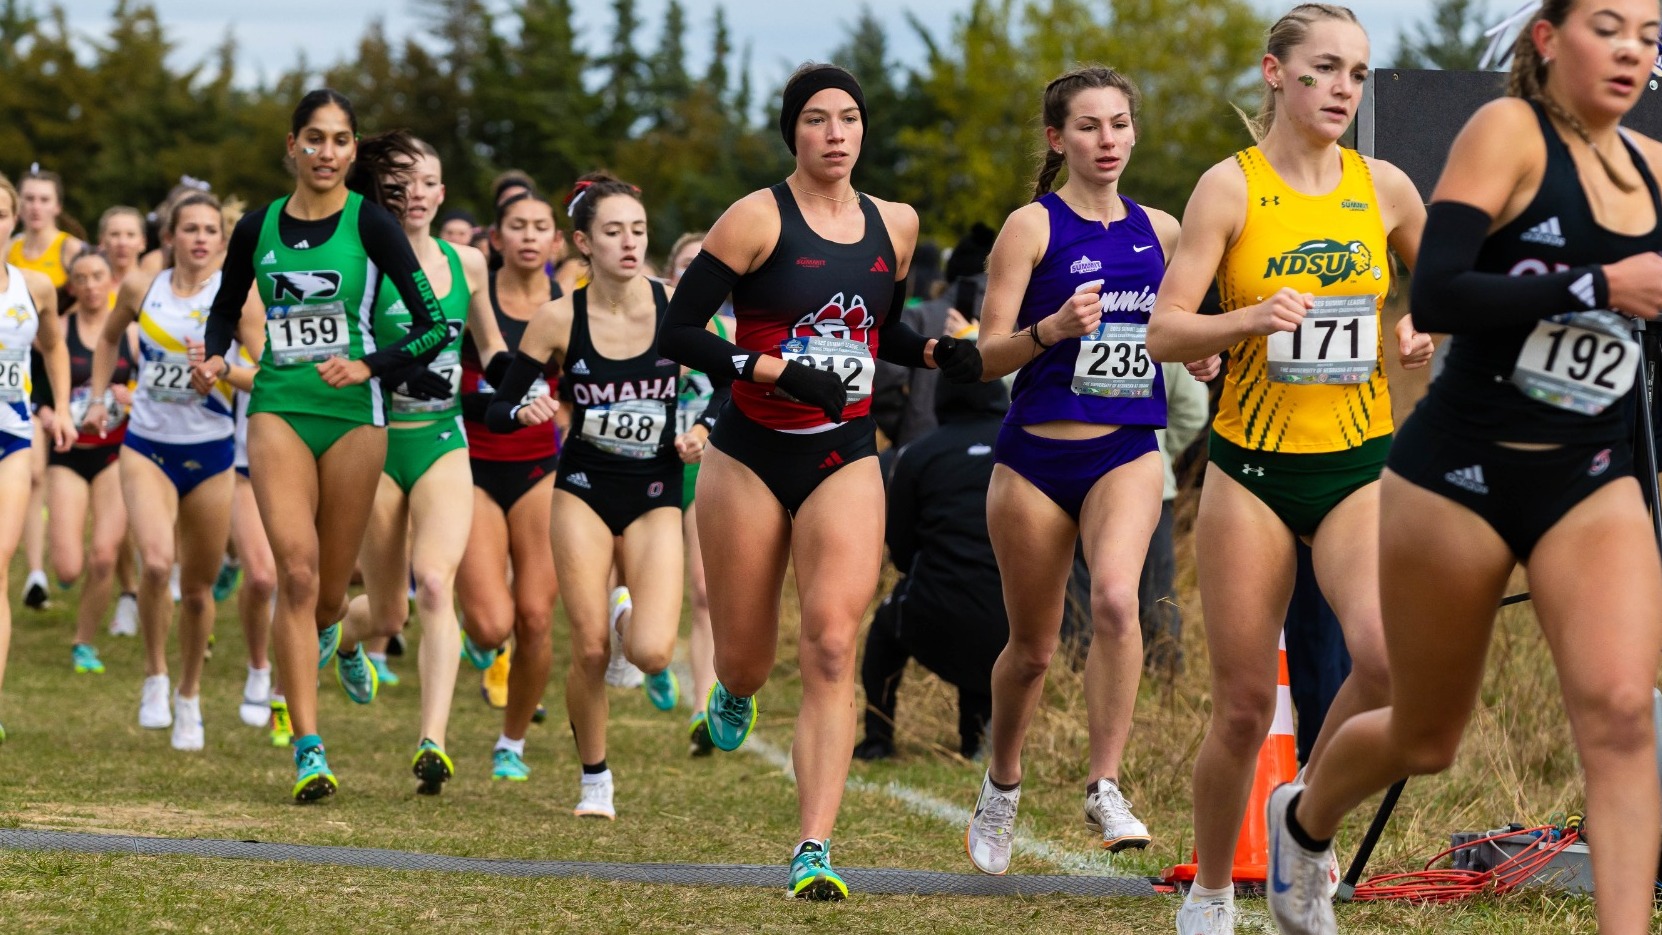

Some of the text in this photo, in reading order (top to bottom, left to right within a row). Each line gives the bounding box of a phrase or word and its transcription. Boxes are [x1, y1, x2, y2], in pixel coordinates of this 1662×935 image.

[1263, 252, 1347, 279] NDSU
[412, 268, 443, 322] NORTH
[280, 316, 338, 347] 159
[1292, 318, 1358, 360] 171
[1087, 342, 1149, 378] 235
[1545, 326, 1625, 389] 192
[573, 376, 676, 406] OMAHA
[598, 411, 654, 442] 188
